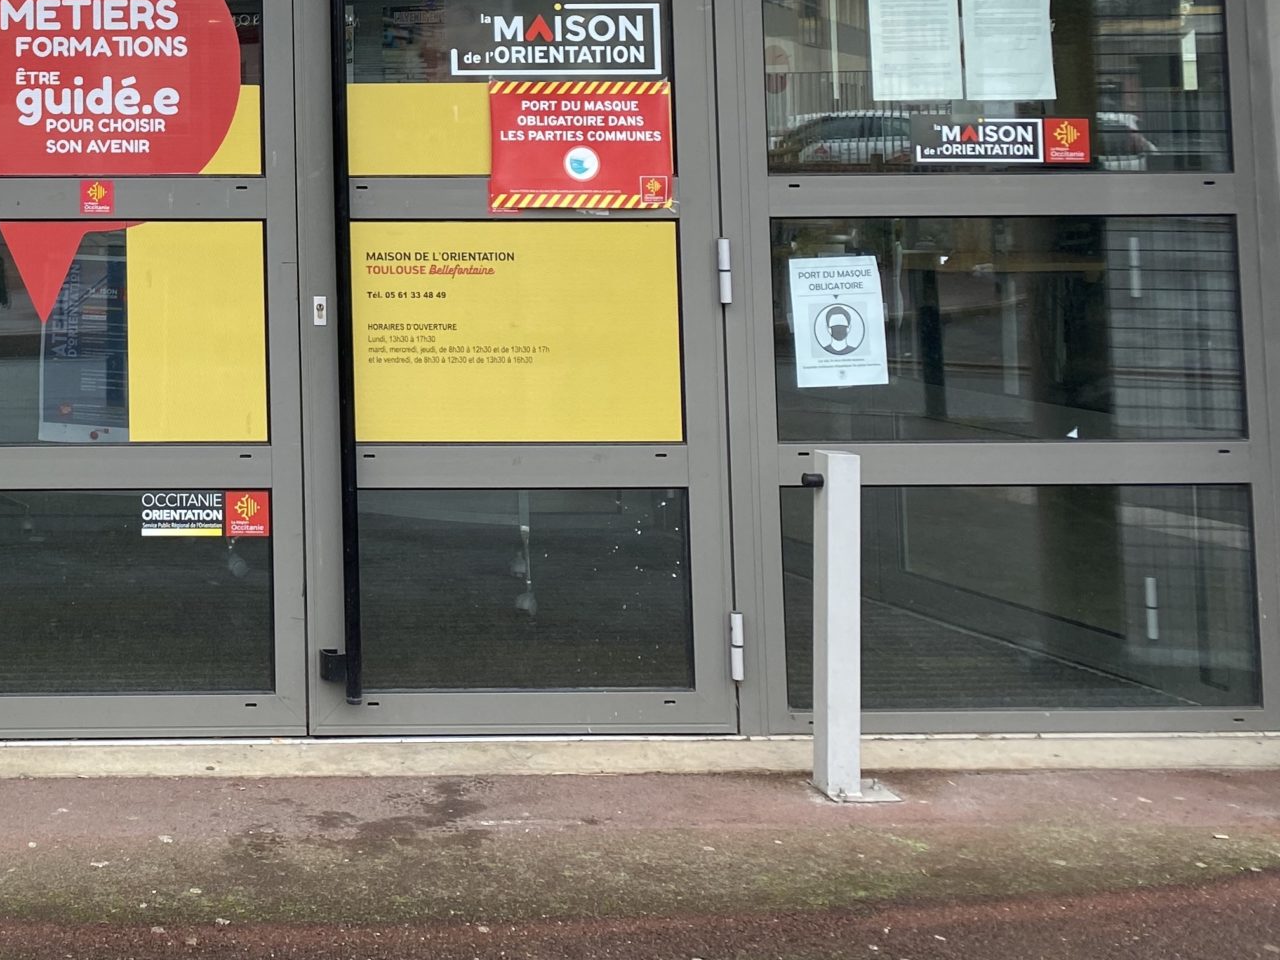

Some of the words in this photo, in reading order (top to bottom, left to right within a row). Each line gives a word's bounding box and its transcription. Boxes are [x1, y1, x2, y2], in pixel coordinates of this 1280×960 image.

[480, 14, 491, 24] la
[494, 14, 644, 42] MAISON
[15, 36, 188, 57] FORMATIONS
[463, 51, 481, 64] de
[486, 45, 645, 64] l'ORIENTATION
[15, 68, 61, 85] ÊTRE
[15, 76, 180, 126] guidé.e
[521, 100, 557, 111] PORT
[561, 100, 581, 111] DU
[584, 100, 639, 112] MASQUE
[45, 118, 94, 132] POUR
[98, 118, 166, 132] CHOISIR
[517, 115, 605, 127] OBLIGATOIRE
[608, 115, 644, 127] DANS
[500, 130, 525, 142] LES
[528, 130, 584, 142] PARTIES
[587, 130, 662, 142] COMMUNES
[942, 125, 1033, 142] MAISON
[46, 140, 82, 153] SON
[86, 140, 150, 153] AVENIR
[924, 147, 935, 155] de
[1050, 150, 1085, 158] Occitanie
[366, 252, 411, 261] MAISON
[415, 252, 429, 261] DE
[433, 252, 515, 261] L'ORIENTATION
[366, 265, 426, 275] TOULOUSE
[429, 264, 496, 279] Bellefontaine
[798, 271, 820, 279] PORT
[822, 270, 836, 278] DU
[837, 269, 872, 278] MASQUE
[809, 282, 864, 291] OBLIGATOIRE
[367, 291, 382, 299] Tél.
[385, 291, 395, 299] 05
[398, 291, 408, 299] 61
[411, 291, 421, 299] 33
[423, 291, 434, 299] 48
[436, 291, 447, 299] 49
[368, 323, 405, 331] HORAIRES
[407, 323, 458, 331] D'OUVERTURE
[389, 335, 409, 343] 13h30
[416, 335, 436, 343] 17h30
[141, 493, 222, 507] OCCITANIE
[142, 509, 223, 520] ORIENTATION
